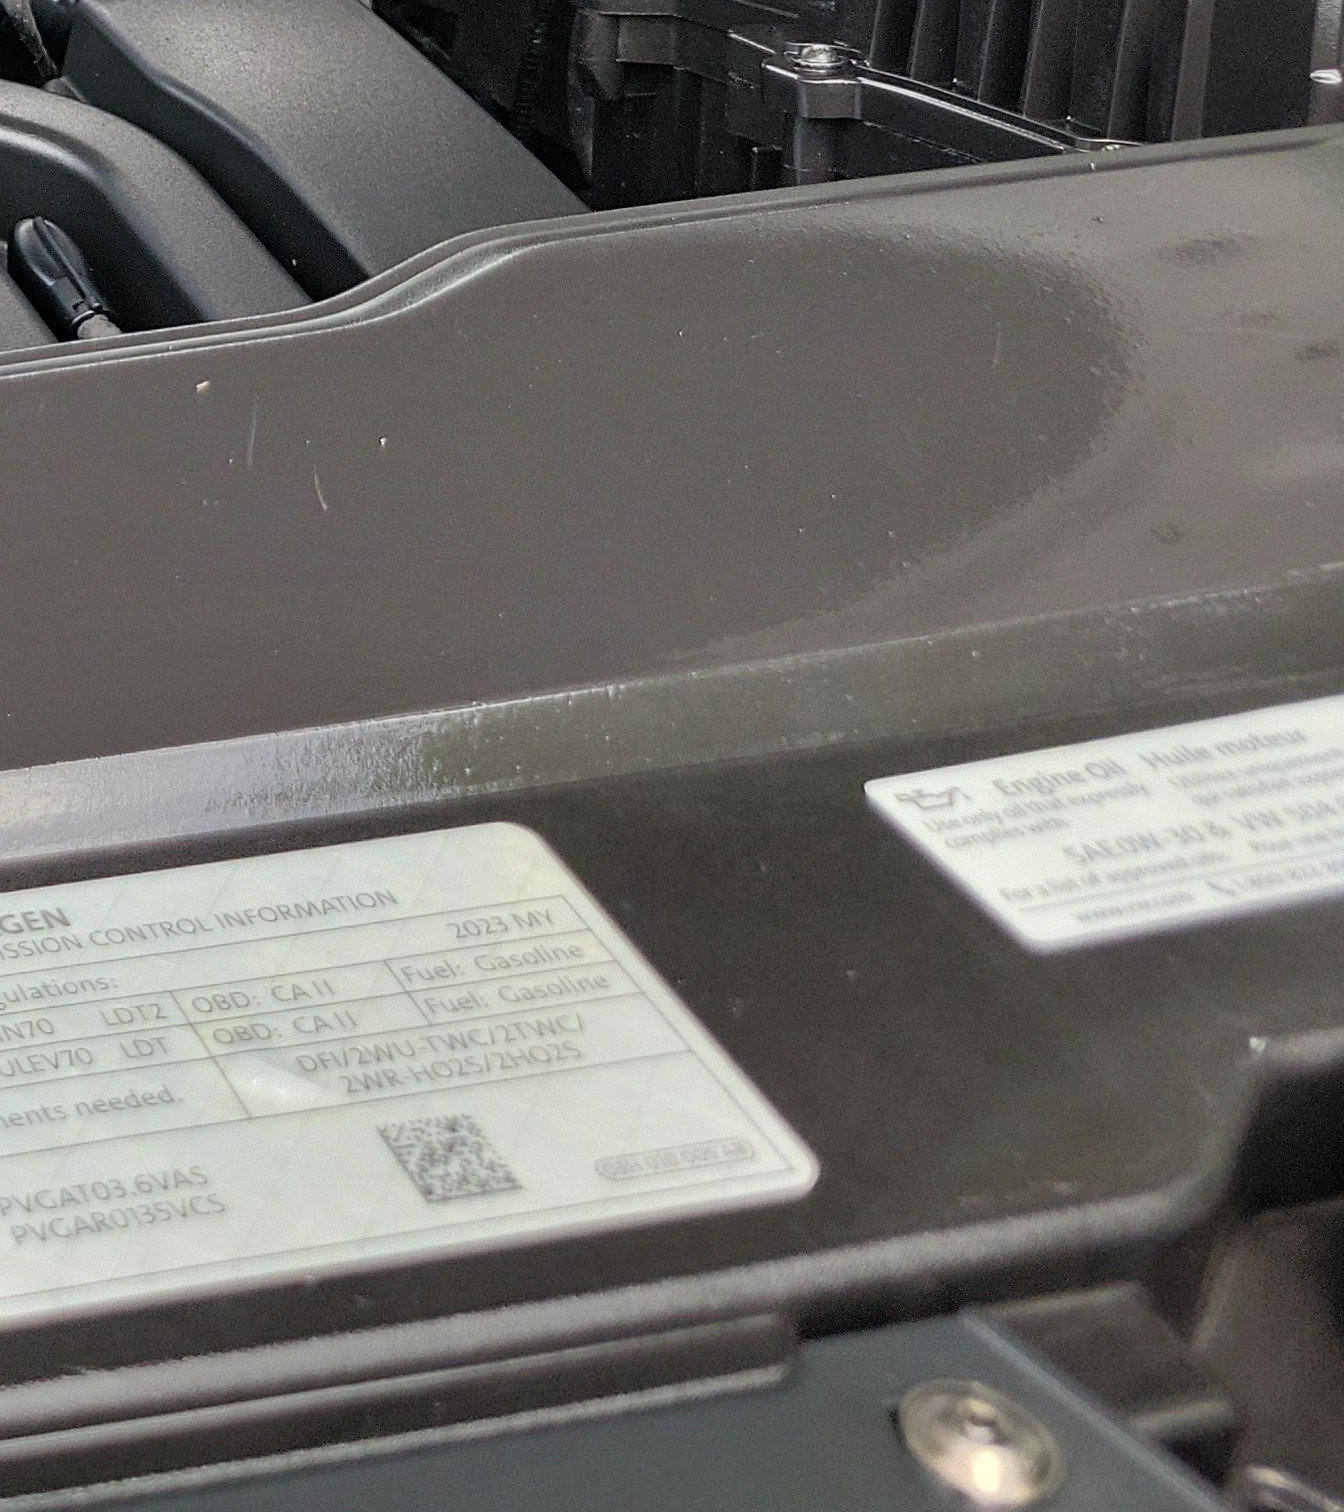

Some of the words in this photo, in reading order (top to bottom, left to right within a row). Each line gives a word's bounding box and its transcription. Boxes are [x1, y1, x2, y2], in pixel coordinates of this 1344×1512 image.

[1138, 744, 1212, 771] Huile
[1214, 729, 1308, 756] moteur
[993, 771, 1085, 796] Engine
[1085, 757, 1127, 780] Oil
[922, 818, 961, 833] Use
[963, 808, 1004, 829] only
[1026, 796, 1065, 813] that
[1023, 817, 1069, 834] with
[1230, 808, 1284, 831] VW
[89, 915, 212, 948] CONTROL
[213, 889, 400, 931] INFORMATION
[448, 916, 509, 941] 2023
[510, 908, 557, 930] MY
[400, 959, 466, 985] Fuel:
[472, 941, 585, 975] Gasoline
[190, 991, 262, 1016] OBD:
[269, 979, 318, 1005] CA
[421, 991, 490, 1017] Fuel:
[496, 971, 611, 1006] Gasoline
[98, 1002, 169, 1027] LDT2
[118, 1035, 171, 1061] LDT
[211, 1022, 283, 1047] OBD:
[72, 1084, 185, 1116] needed.
